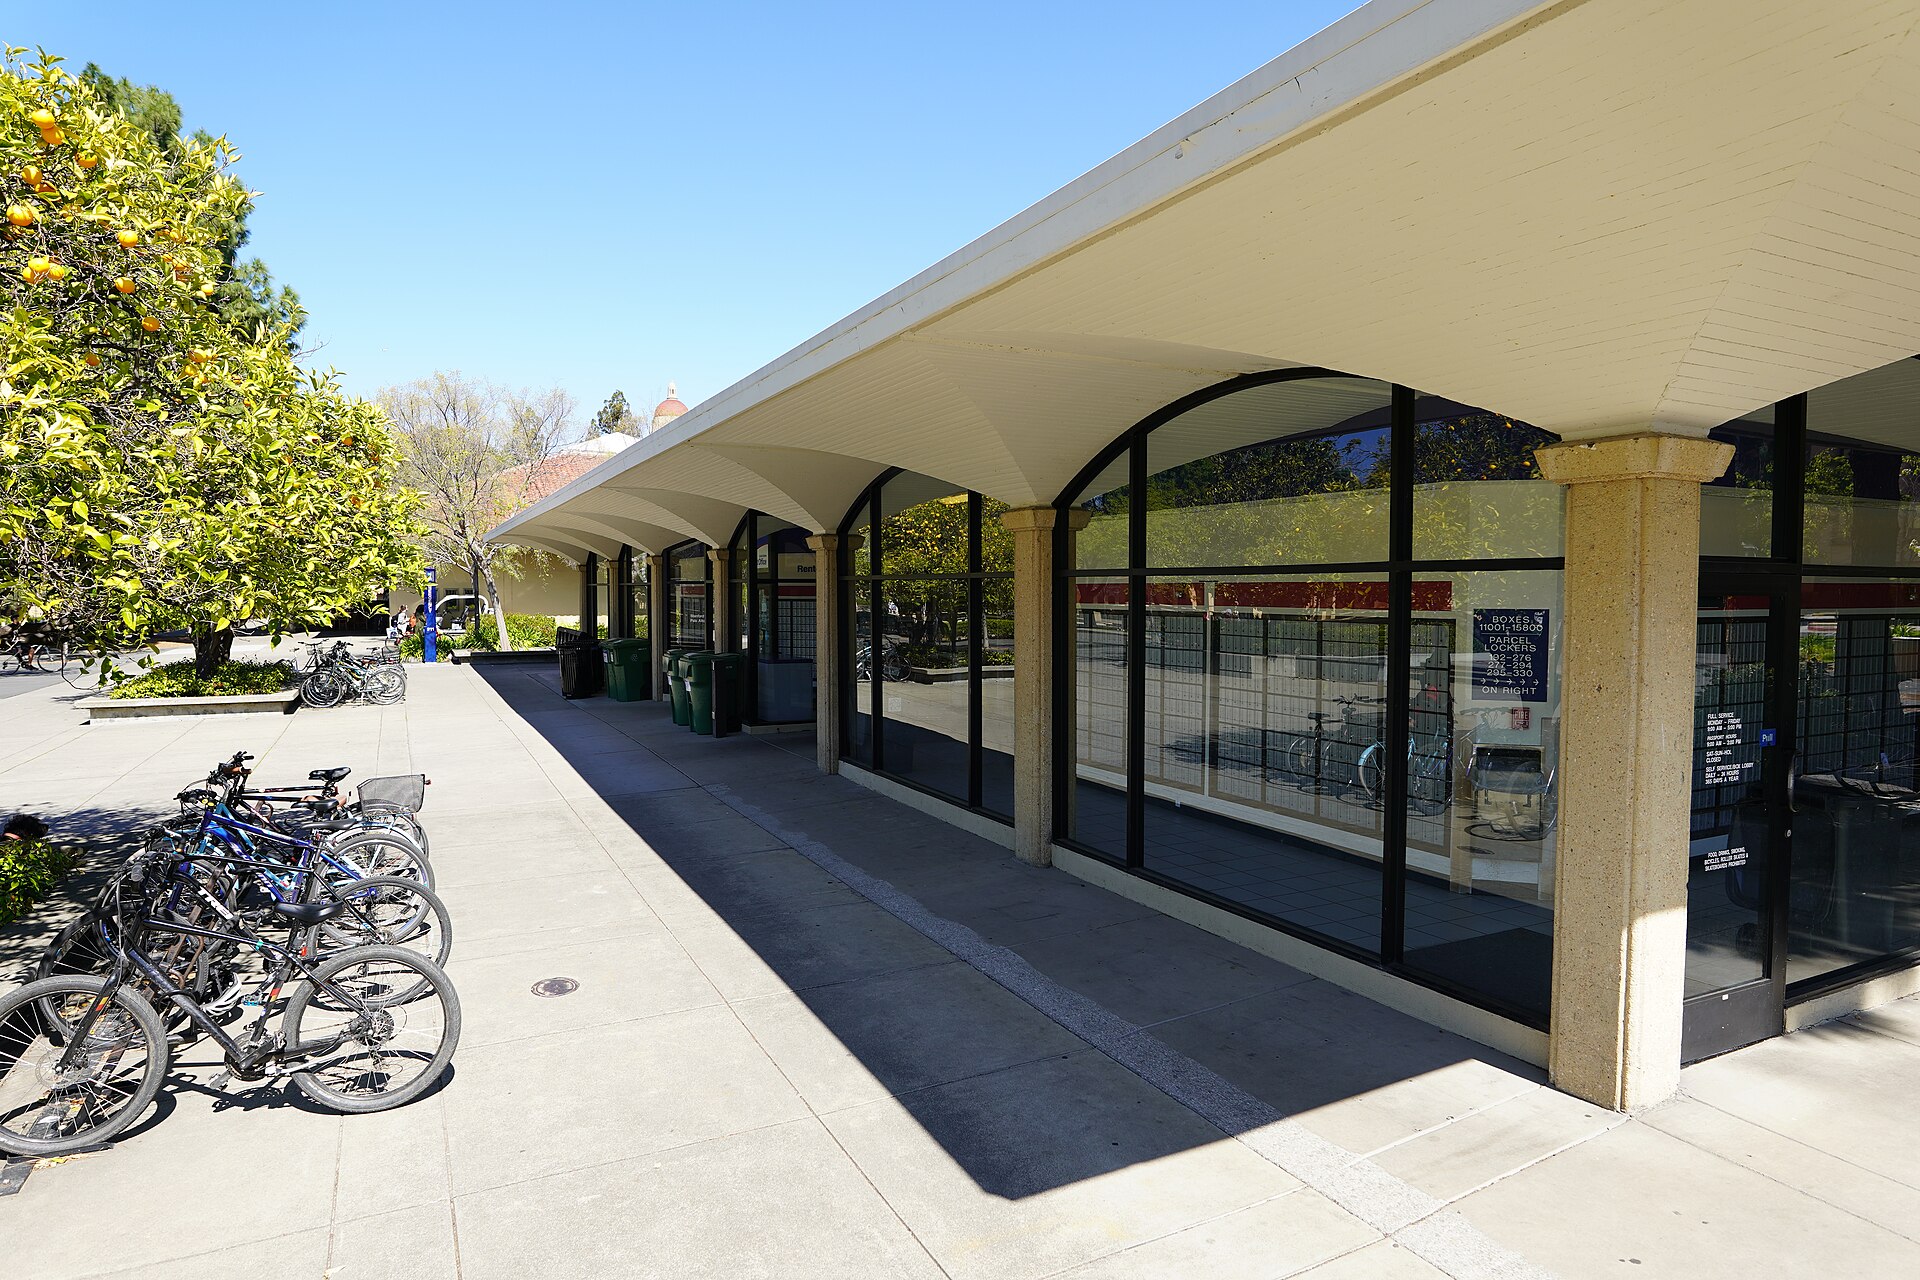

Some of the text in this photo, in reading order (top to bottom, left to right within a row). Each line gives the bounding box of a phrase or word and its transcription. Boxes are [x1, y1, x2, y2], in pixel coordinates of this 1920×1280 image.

[1480, 624, 1544, 632] 11001-15800
[1514, 711, 1528, 719] FIRE
[1762, 734, 1773, 742] Pull
